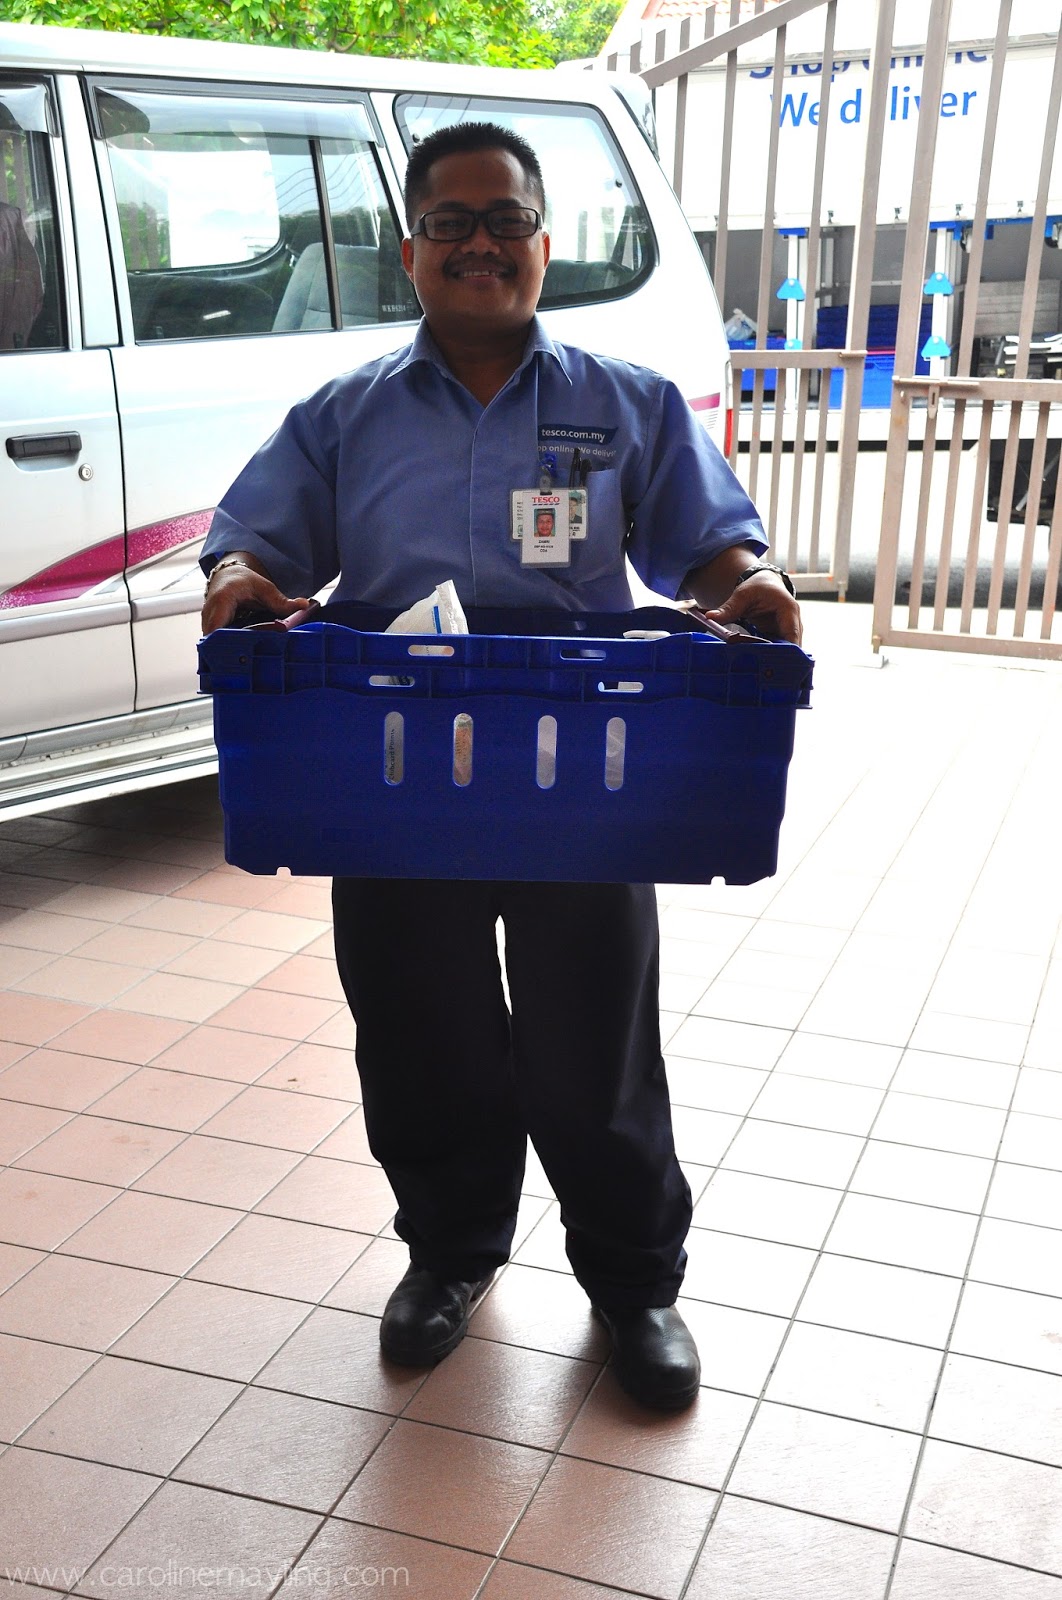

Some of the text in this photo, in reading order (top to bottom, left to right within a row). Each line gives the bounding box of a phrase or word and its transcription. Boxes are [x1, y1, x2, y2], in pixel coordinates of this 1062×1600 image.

[769, 86, 977, 128] We dlier
[541, 428, 606, 443] tesco.com.my
[548, 444, 575, 454] online
